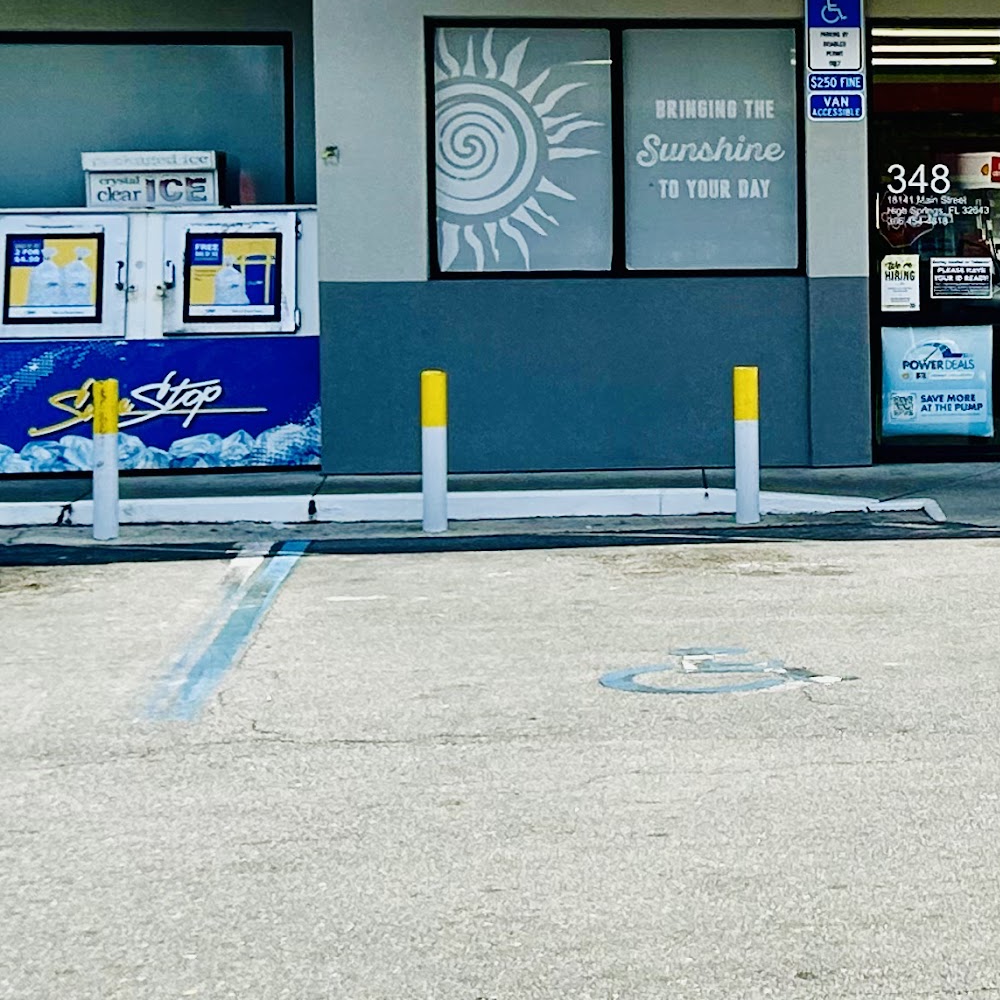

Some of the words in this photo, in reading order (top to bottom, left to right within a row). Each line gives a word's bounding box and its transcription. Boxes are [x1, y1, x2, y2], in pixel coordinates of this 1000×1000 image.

[810, 76, 837, 89] $250
[840, 76, 861, 88] FINE
[823, 96, 849, 107] VAN
[655, 100, 737, 119] BRINGING
[744, 100, 775, 119] THE
[812, 108, 860, 117] ACCESSIBLE
[636, 134, 785, 167] Sunshine
[99, 176, 140, 185] crystal
[886, 163, 950, 194] 348
[97, 187, 142, 202] clear
[145, 177, 207, 202] ICE
[658, 179, 679, 198] TO
[686, 179, 731, 198] YOUR
[738, 179, 770, 198] DAY
[916, 194, 938, 205] Main
[940, 194, 967, 205] Street
[948, 206, 960, 215] FL
[885, 270, 915, 281] HIRING
[902, 360, 943, 370] POWER
[945, 359, 975, 370] DEALS
[921, 395, 944, 403] SAVE
[946, 394, 975, 402] MORE
[921, 404, 931, 412] AT
[954, 403, 983, 411] PUMP
